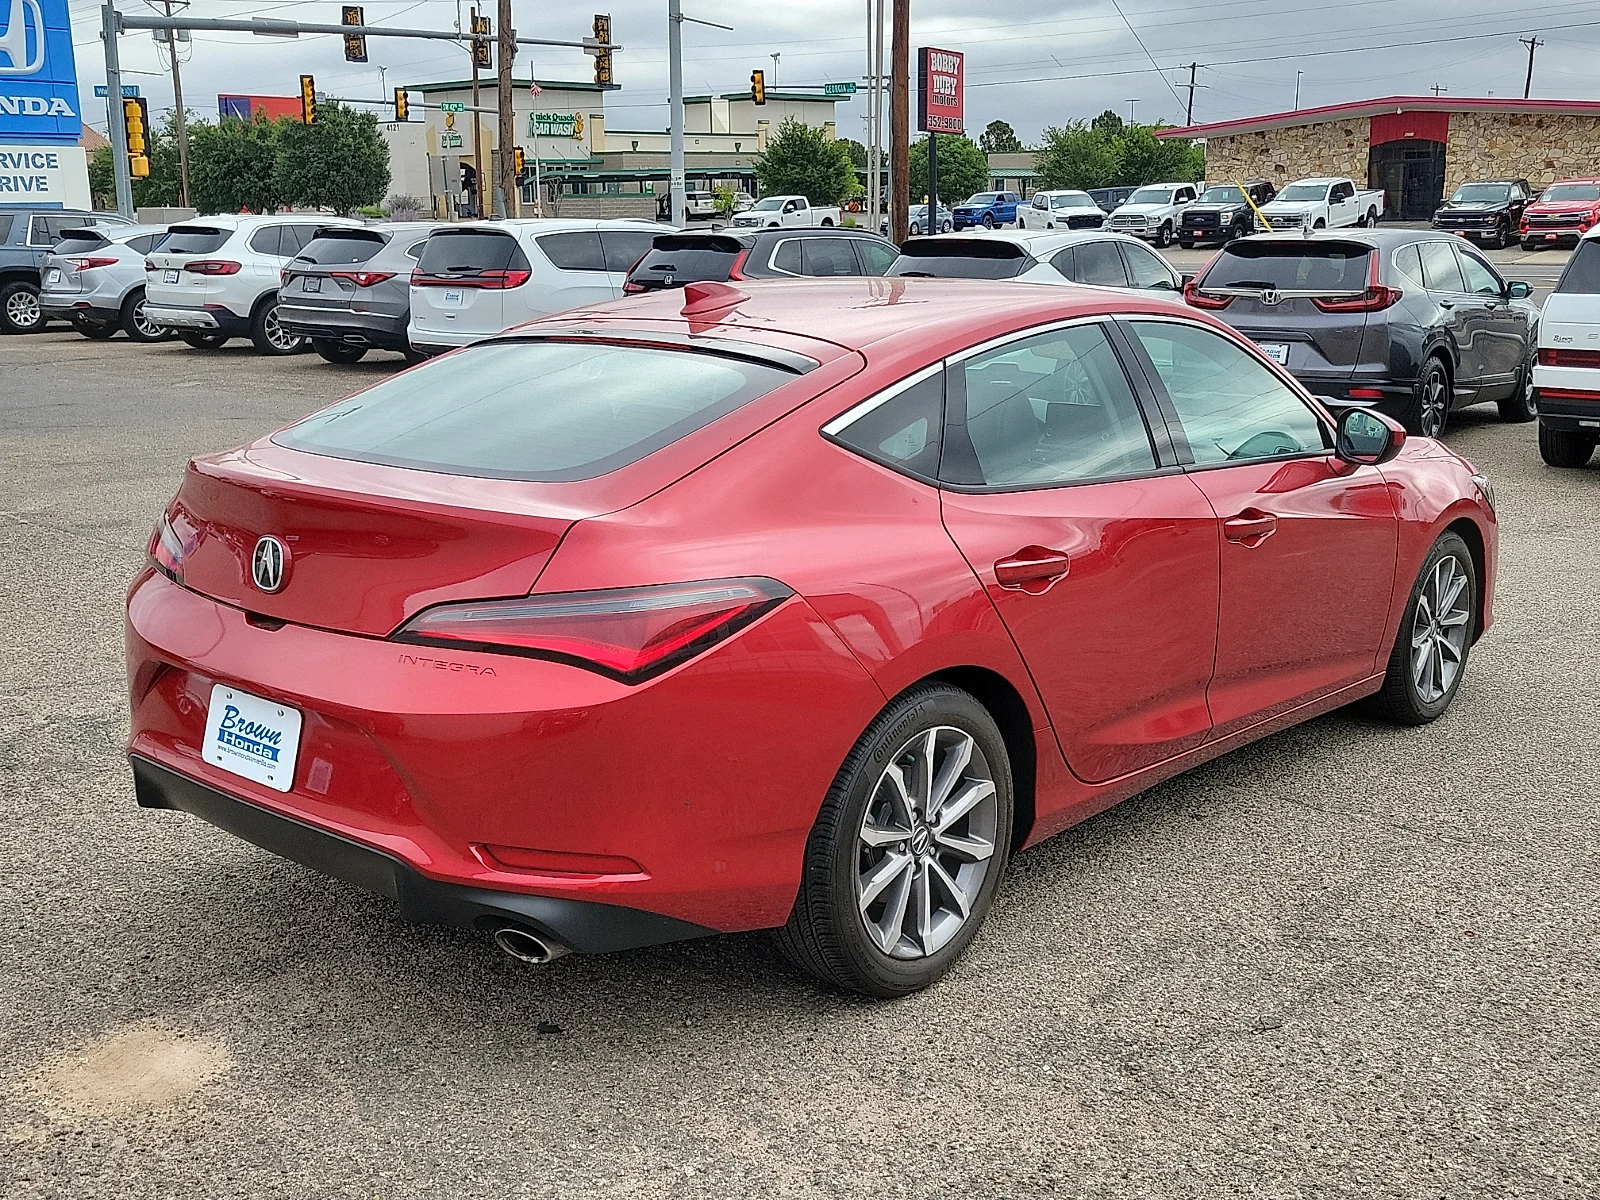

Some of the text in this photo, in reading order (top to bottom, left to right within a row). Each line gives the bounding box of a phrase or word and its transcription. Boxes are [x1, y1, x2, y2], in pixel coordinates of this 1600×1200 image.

[930, 52, 960, 76] BOBBY
[825, 84, 847, 94] GEORGIA
[932, 74, 958, 96] DUBY
[932, 94, 958, 107] motors
[530, 111, 574, 123] Quick Quack
[928, 115, 962, 130] 352-9800
[386, 123, 400, 131] 4121
[533, 122, 574, 136] CAR WASH
[398, 654, 497, 677] INTEGRA
[221, 704, 282, 746] Brown
[873, 707, 919, 763] Continental
[223, 731, 273, 759] Honda
